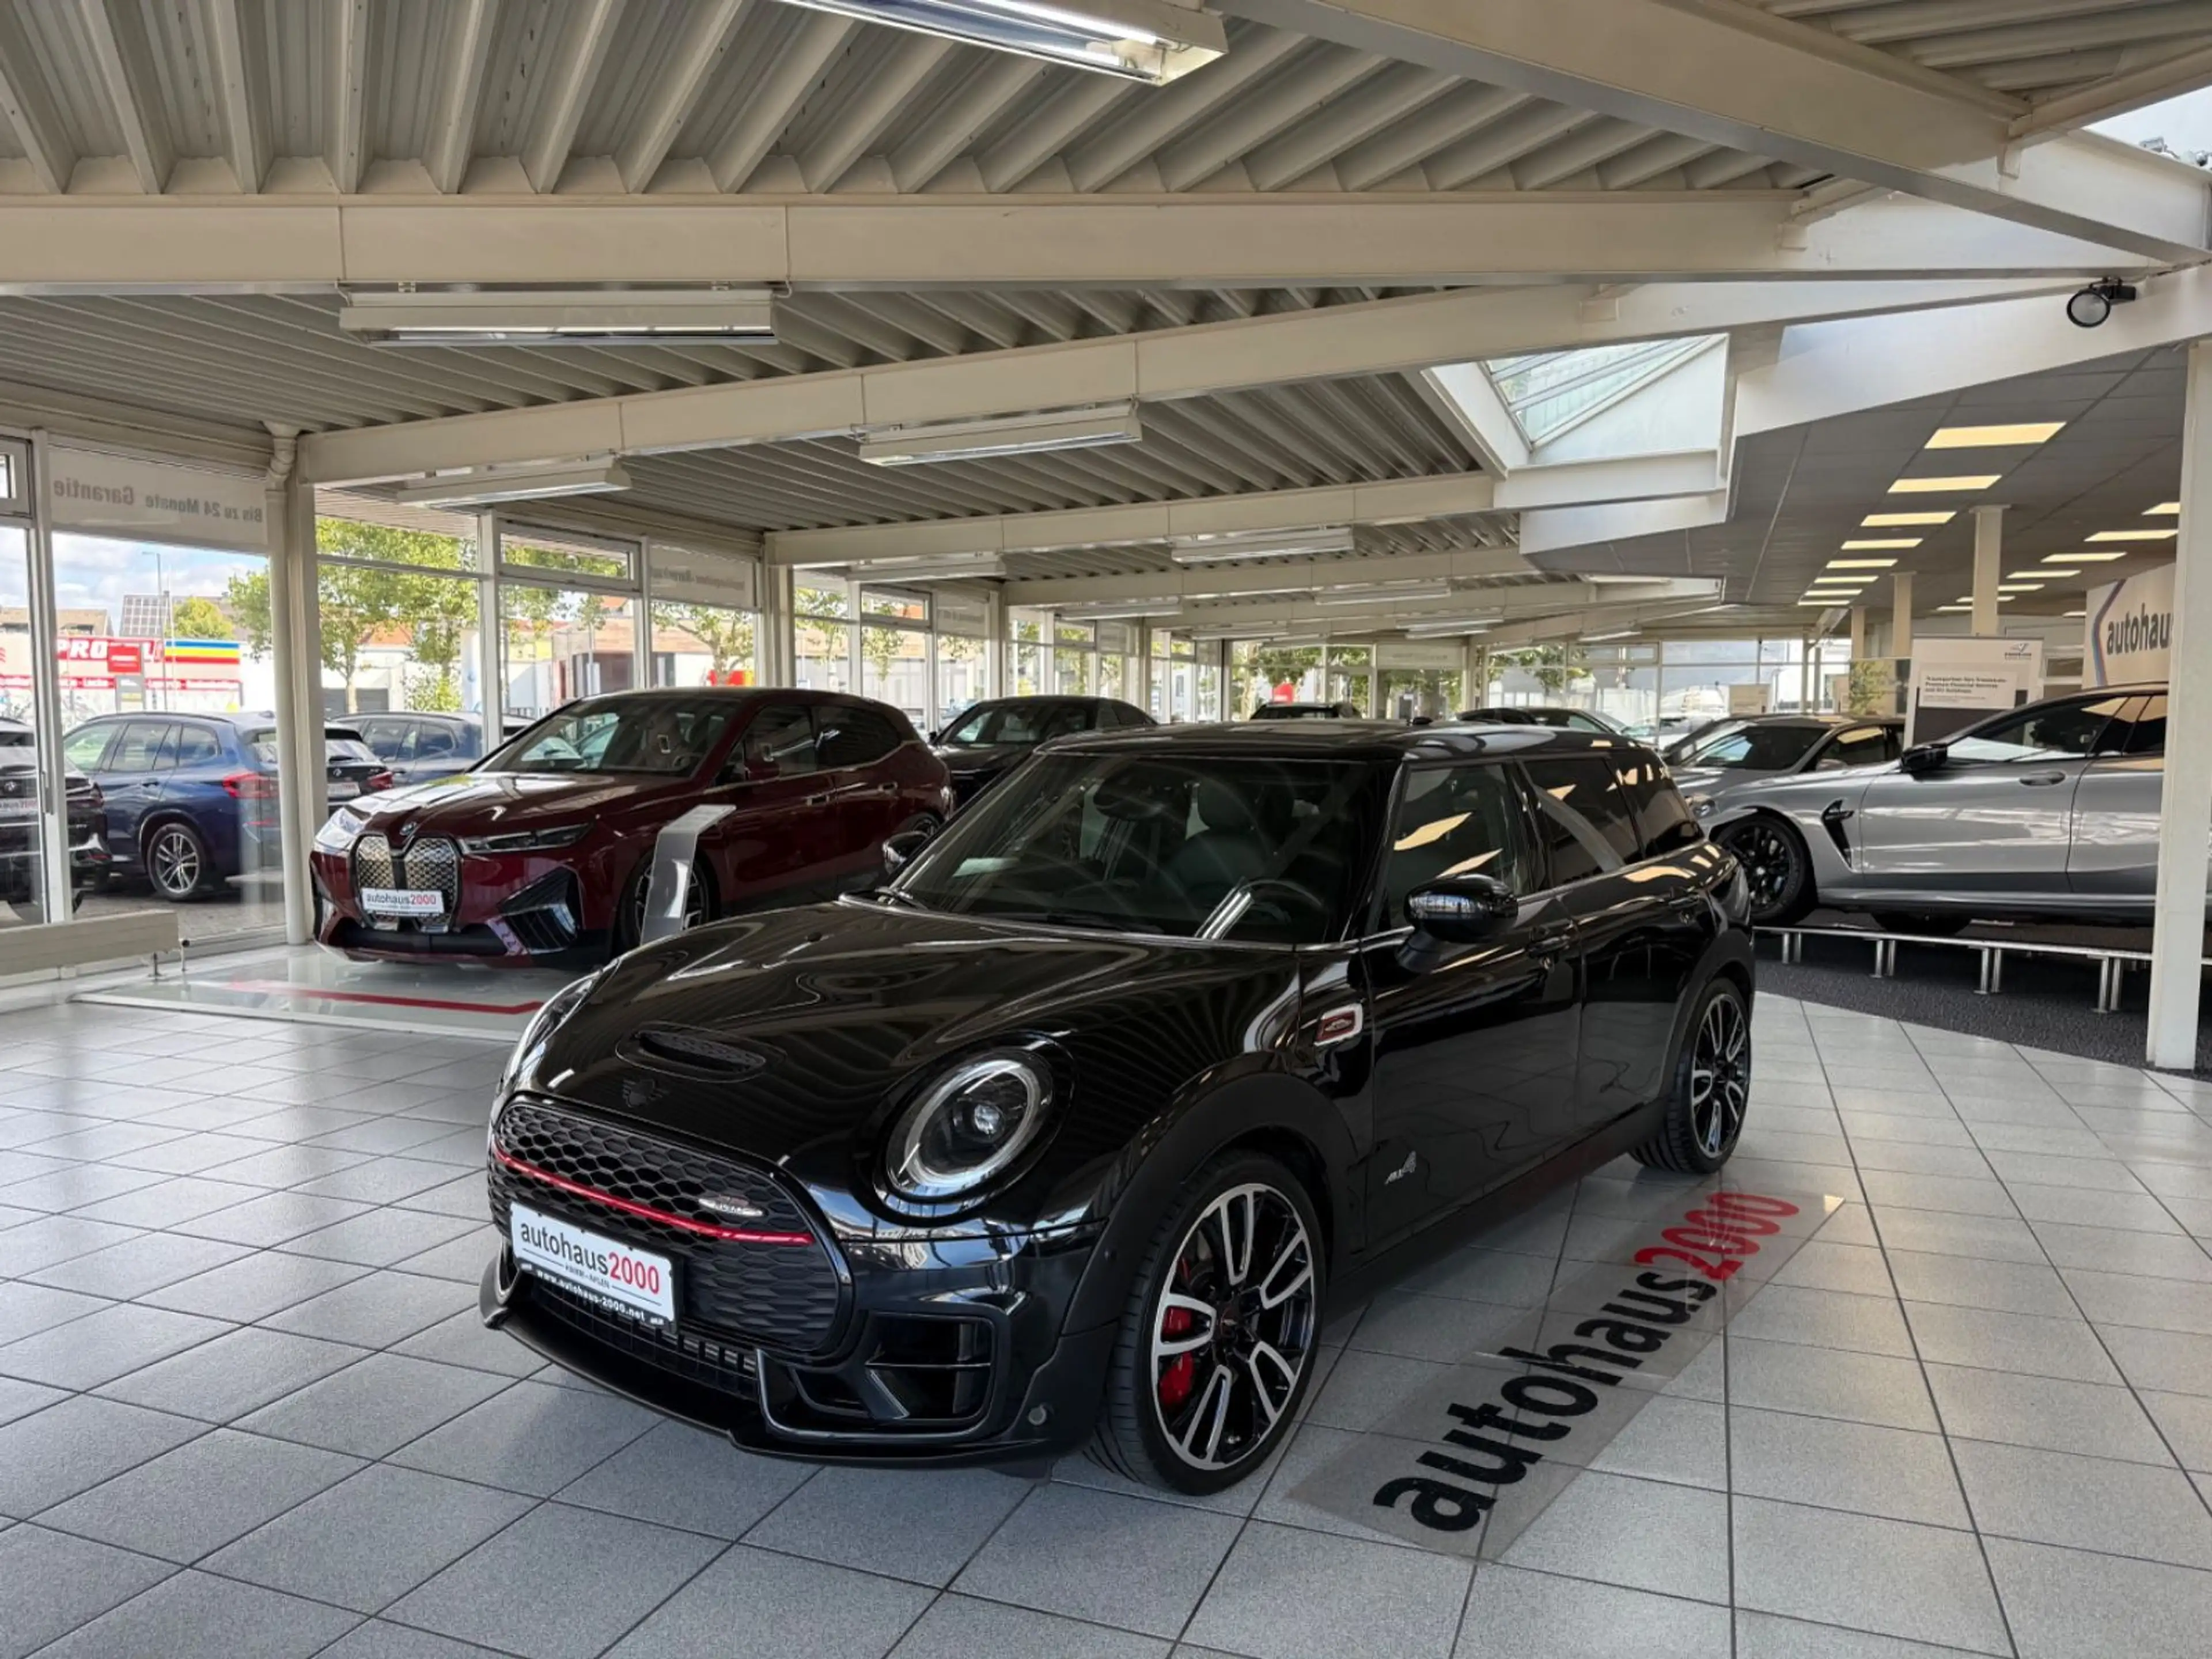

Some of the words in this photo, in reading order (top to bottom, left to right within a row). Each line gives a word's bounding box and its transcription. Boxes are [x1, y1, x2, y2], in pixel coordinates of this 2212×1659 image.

[2107, 602, 2174, 656] autohau
[366, 892, 437, 905] autohaus2000
[520, 1222, 660, 1295] autohaus2000
[536, 1269, 645, 1322] www.autohaus-2000.net
[1373, 1191, 1800, 1532] autohaus2000
